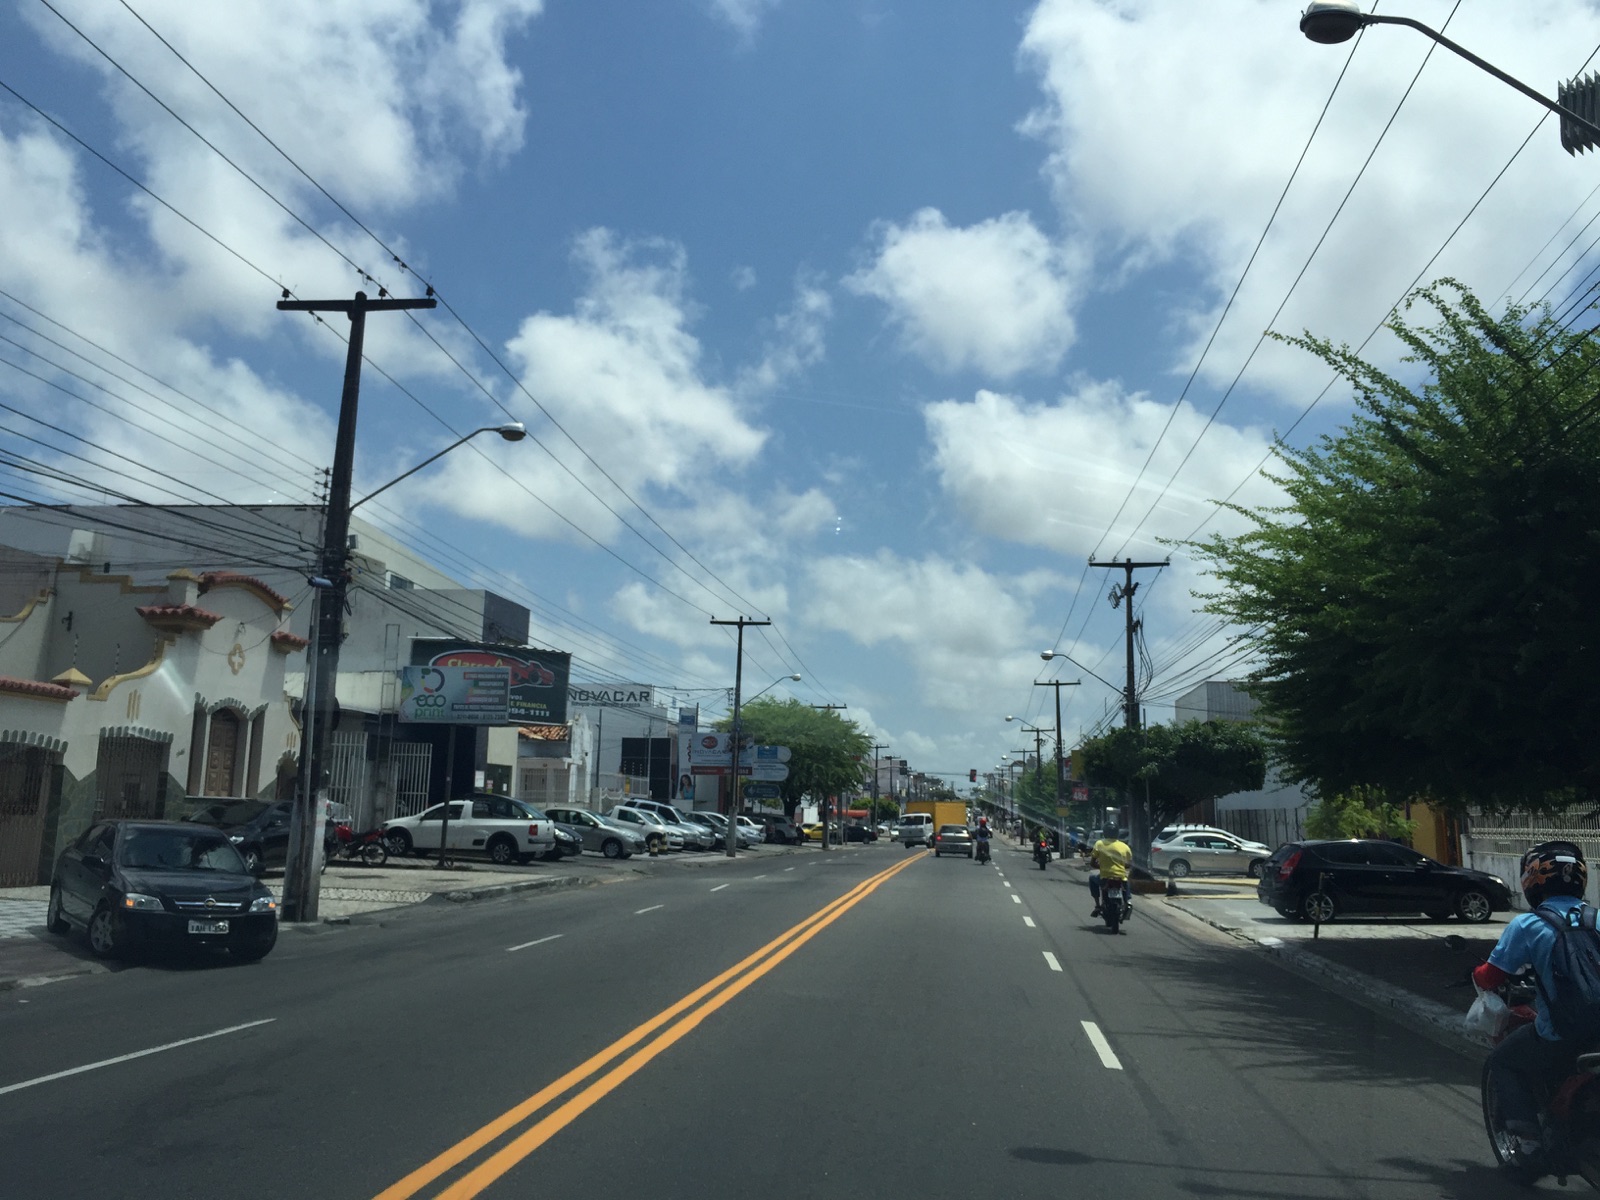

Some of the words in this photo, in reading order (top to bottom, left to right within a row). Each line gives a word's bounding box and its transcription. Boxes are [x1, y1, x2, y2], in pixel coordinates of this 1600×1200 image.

[412, 694, 447, 708] eco
[568, 691, 650, 702] NOVACAR
[414, 707, 445, 720] print
